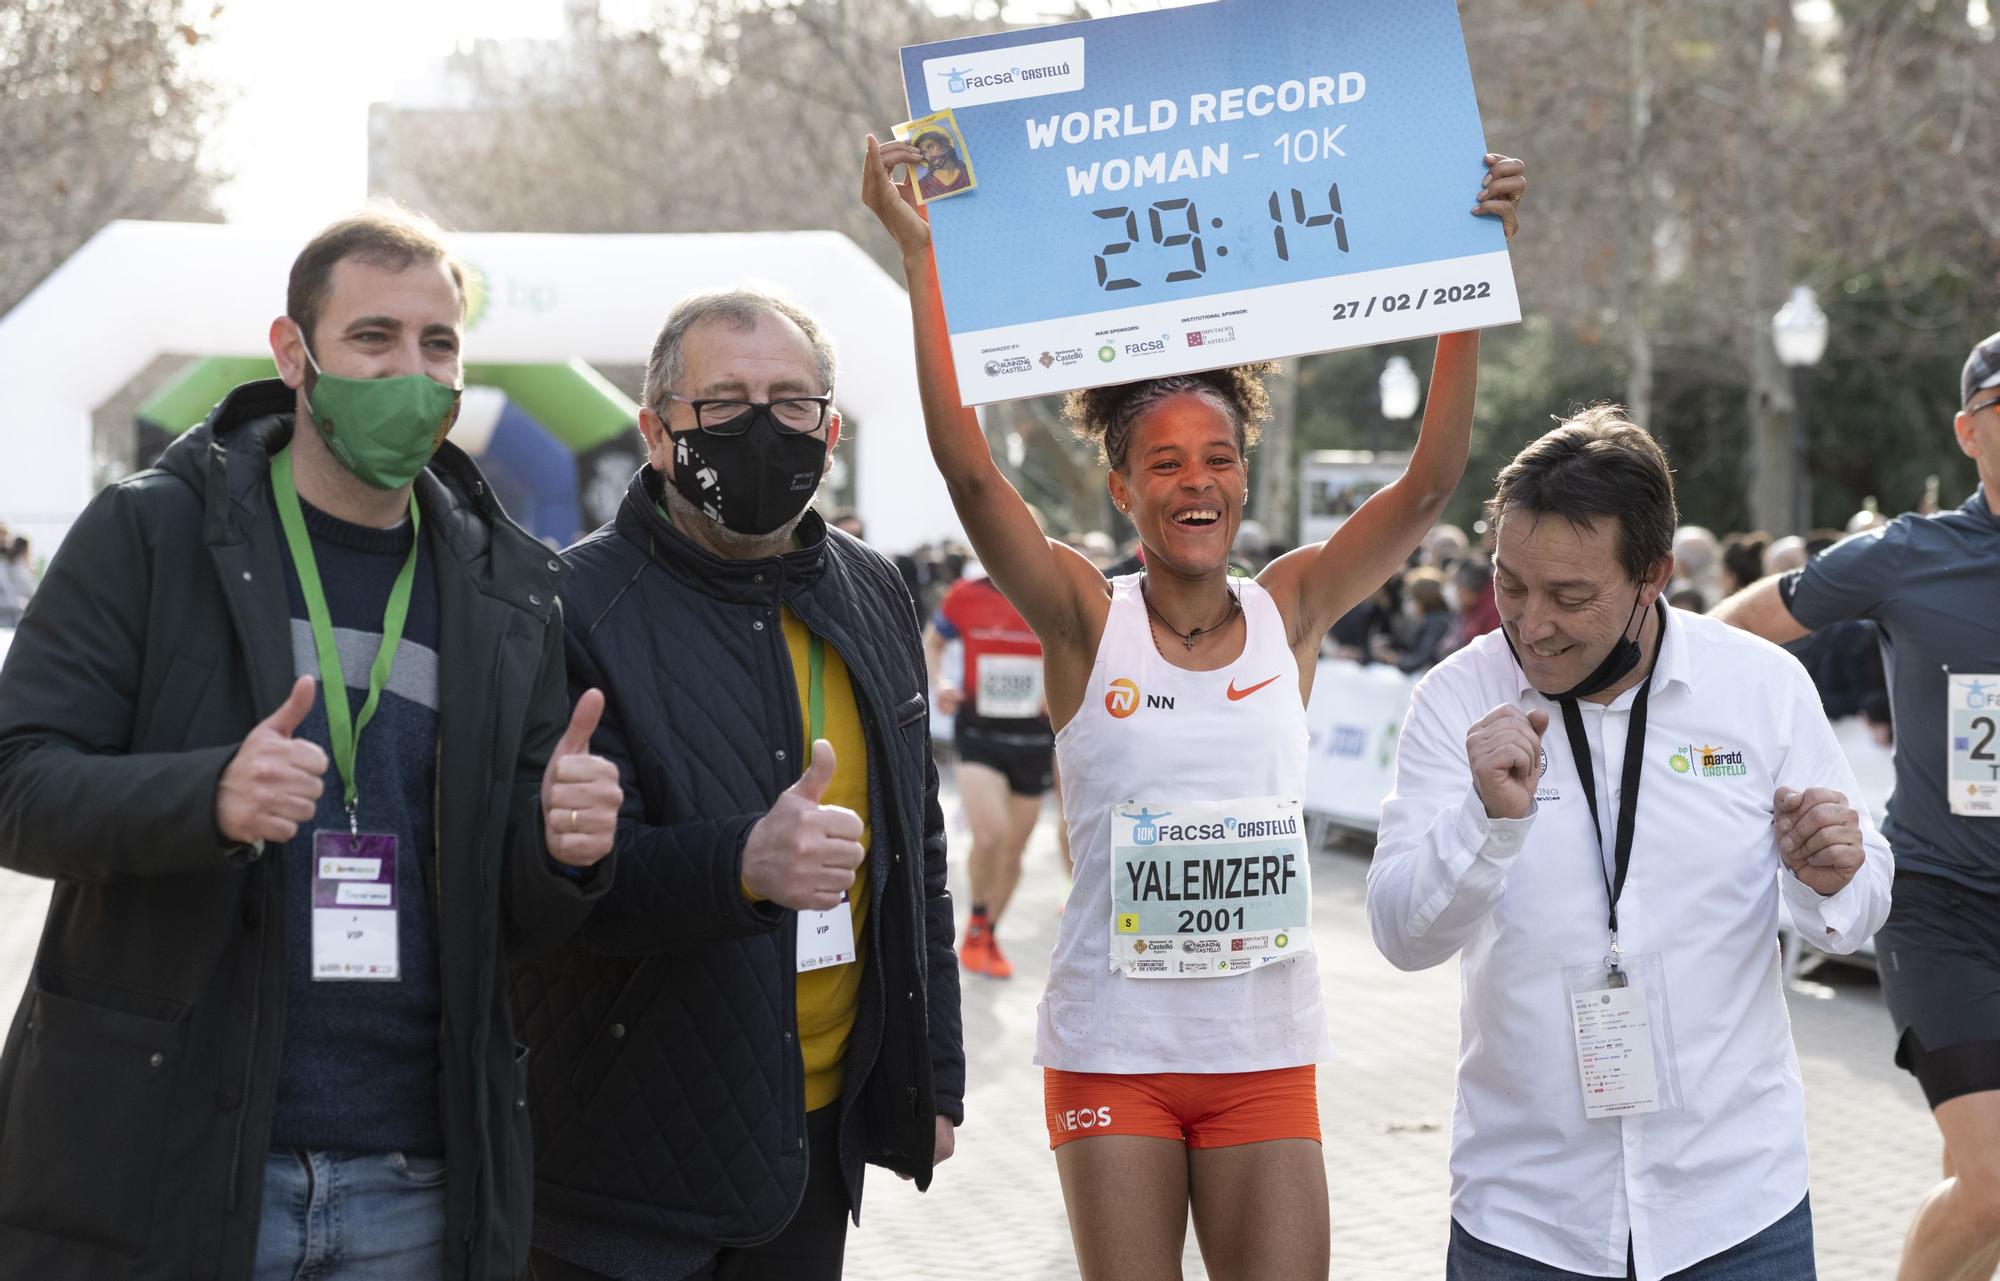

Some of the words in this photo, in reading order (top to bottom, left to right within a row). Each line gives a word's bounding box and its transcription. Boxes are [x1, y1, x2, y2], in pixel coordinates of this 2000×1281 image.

[1021, 61, 1070, 81] CASTELLÓ
[1025, 99, 1178, 150] WORLD
[1189, 71, 1367, 126] RECORD
[1066, 143, 1230, 197] WOMAN
[1273, 124, 1348, 165] 10K
[1181, 313, 1220, 323] INSTITUTIONAL
[1221, 309, 1248, 317] SPONSOR:
[1110, 325, 1140, 334] SPONSORS:
[981, 345, 1011, 354] ORGANIZED
[1055, 351, 1083, 362] Castelló
[1147, 695, 1175, 710] NN
[1678, 746, 1688, 755] bp
[1703, 751, 1742, 766] marató
[1703, 763, 1746, 777] CASTELLÓ
[1137, 825, 1154, 841] 10K
[1238, 816, 1296, 838] CASTELLÓ
[1126, 854, 1296, 901] YALEMZERF
[1125, 918, 1131, 928] S
[1178, 907, 1244, 933] 2001
[346, 931, 363, 939] VIP
[817, 926, 829, 936] VIP
[1055, 1106, 1112, 1133] INEOS
